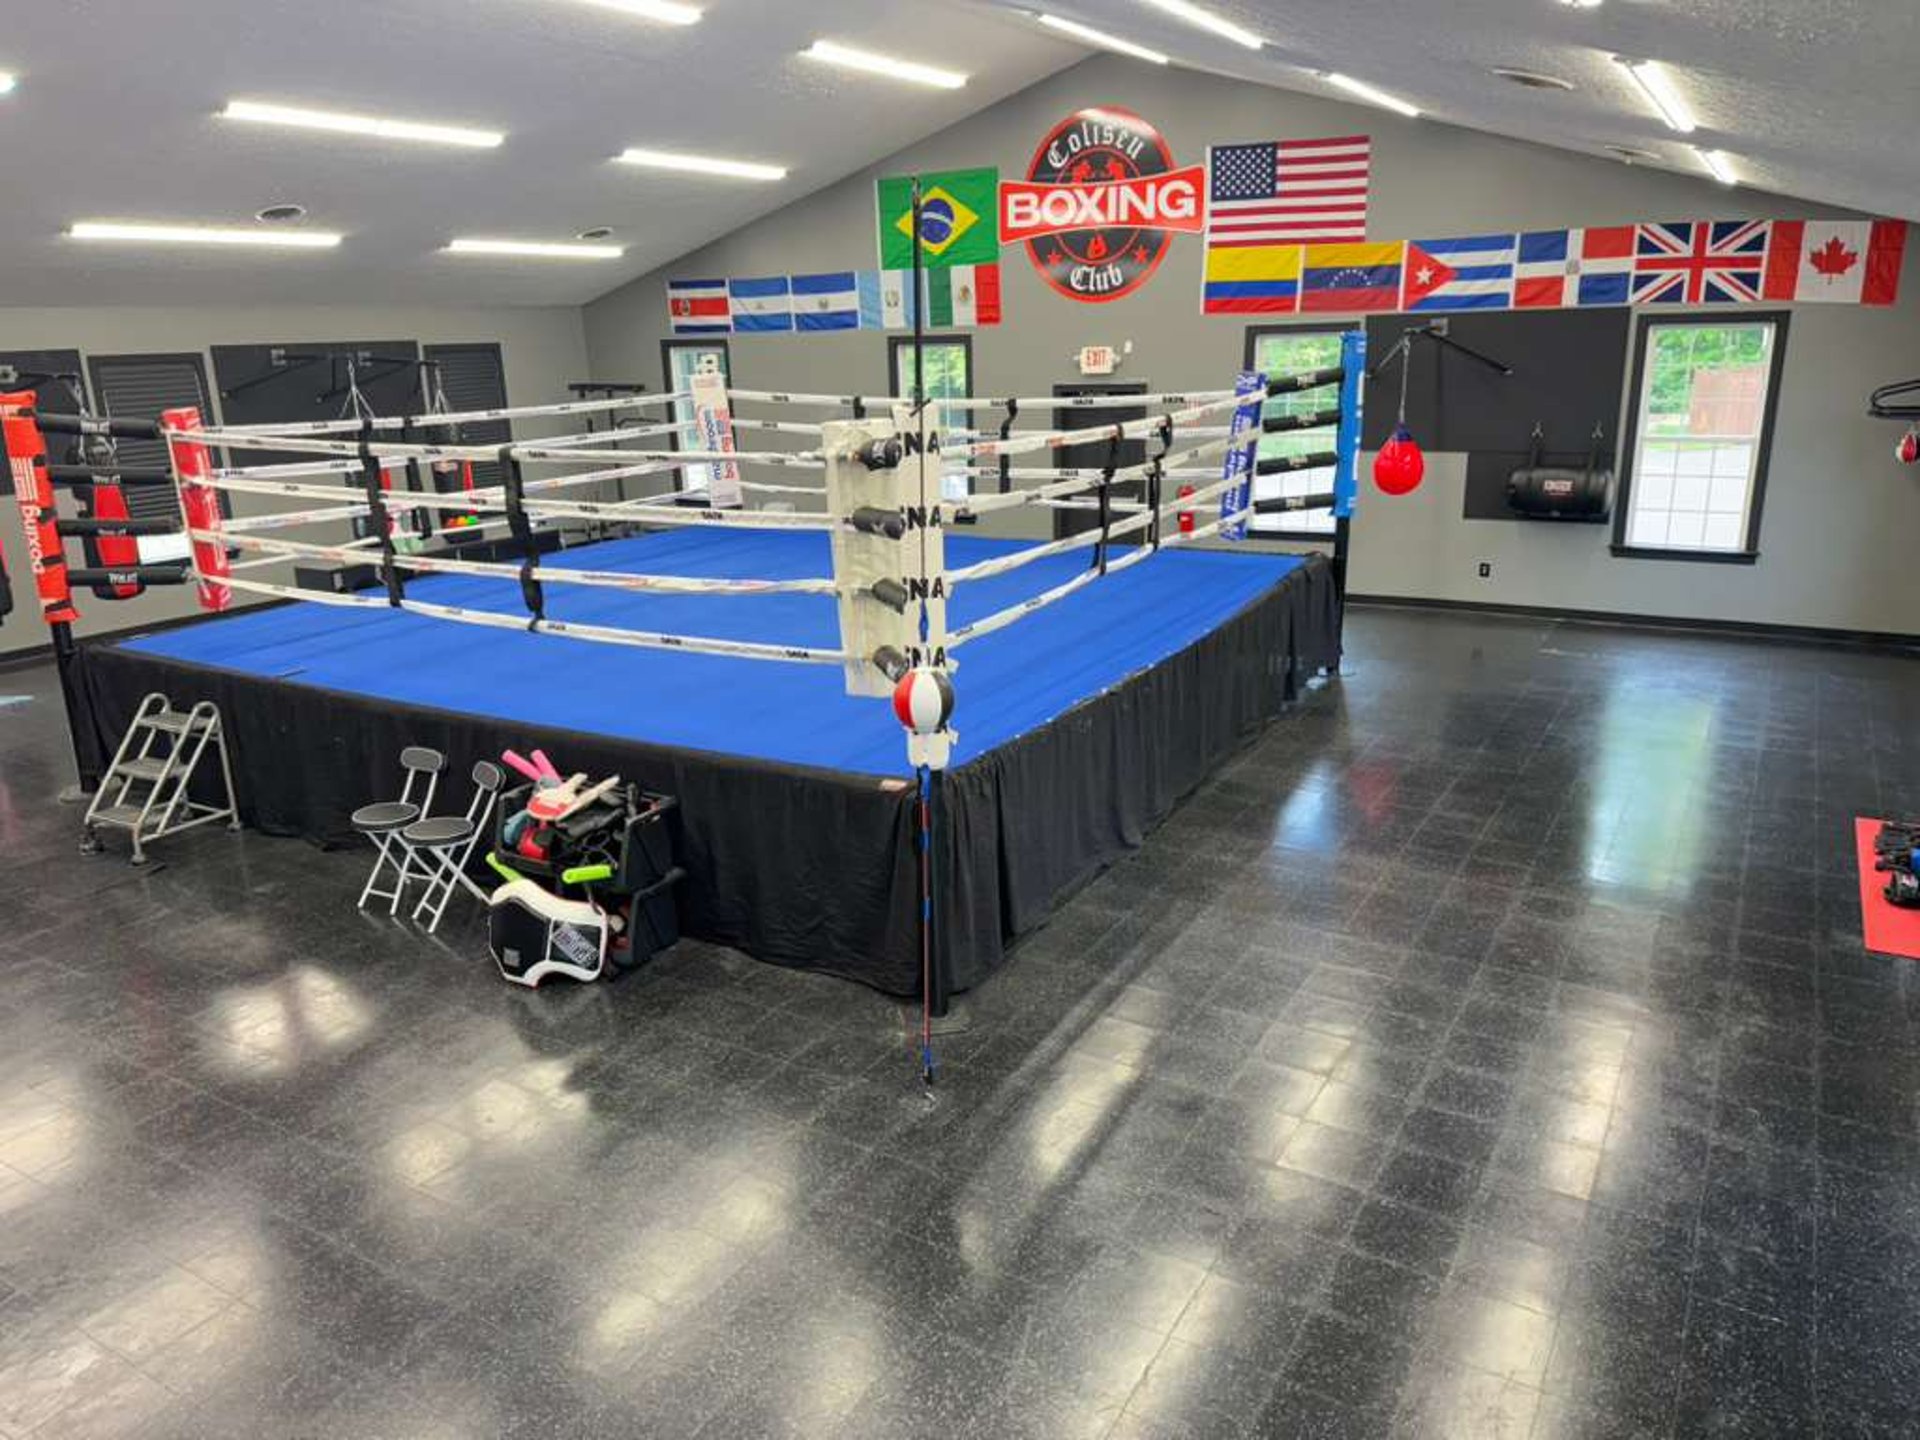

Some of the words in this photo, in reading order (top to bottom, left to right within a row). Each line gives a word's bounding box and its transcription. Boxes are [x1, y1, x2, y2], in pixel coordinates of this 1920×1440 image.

[1047, 121, 1144, 169] Coliseu
[1006, 180, 1197, 229] BOXING
[1069, 262, 1124, 292] Club
